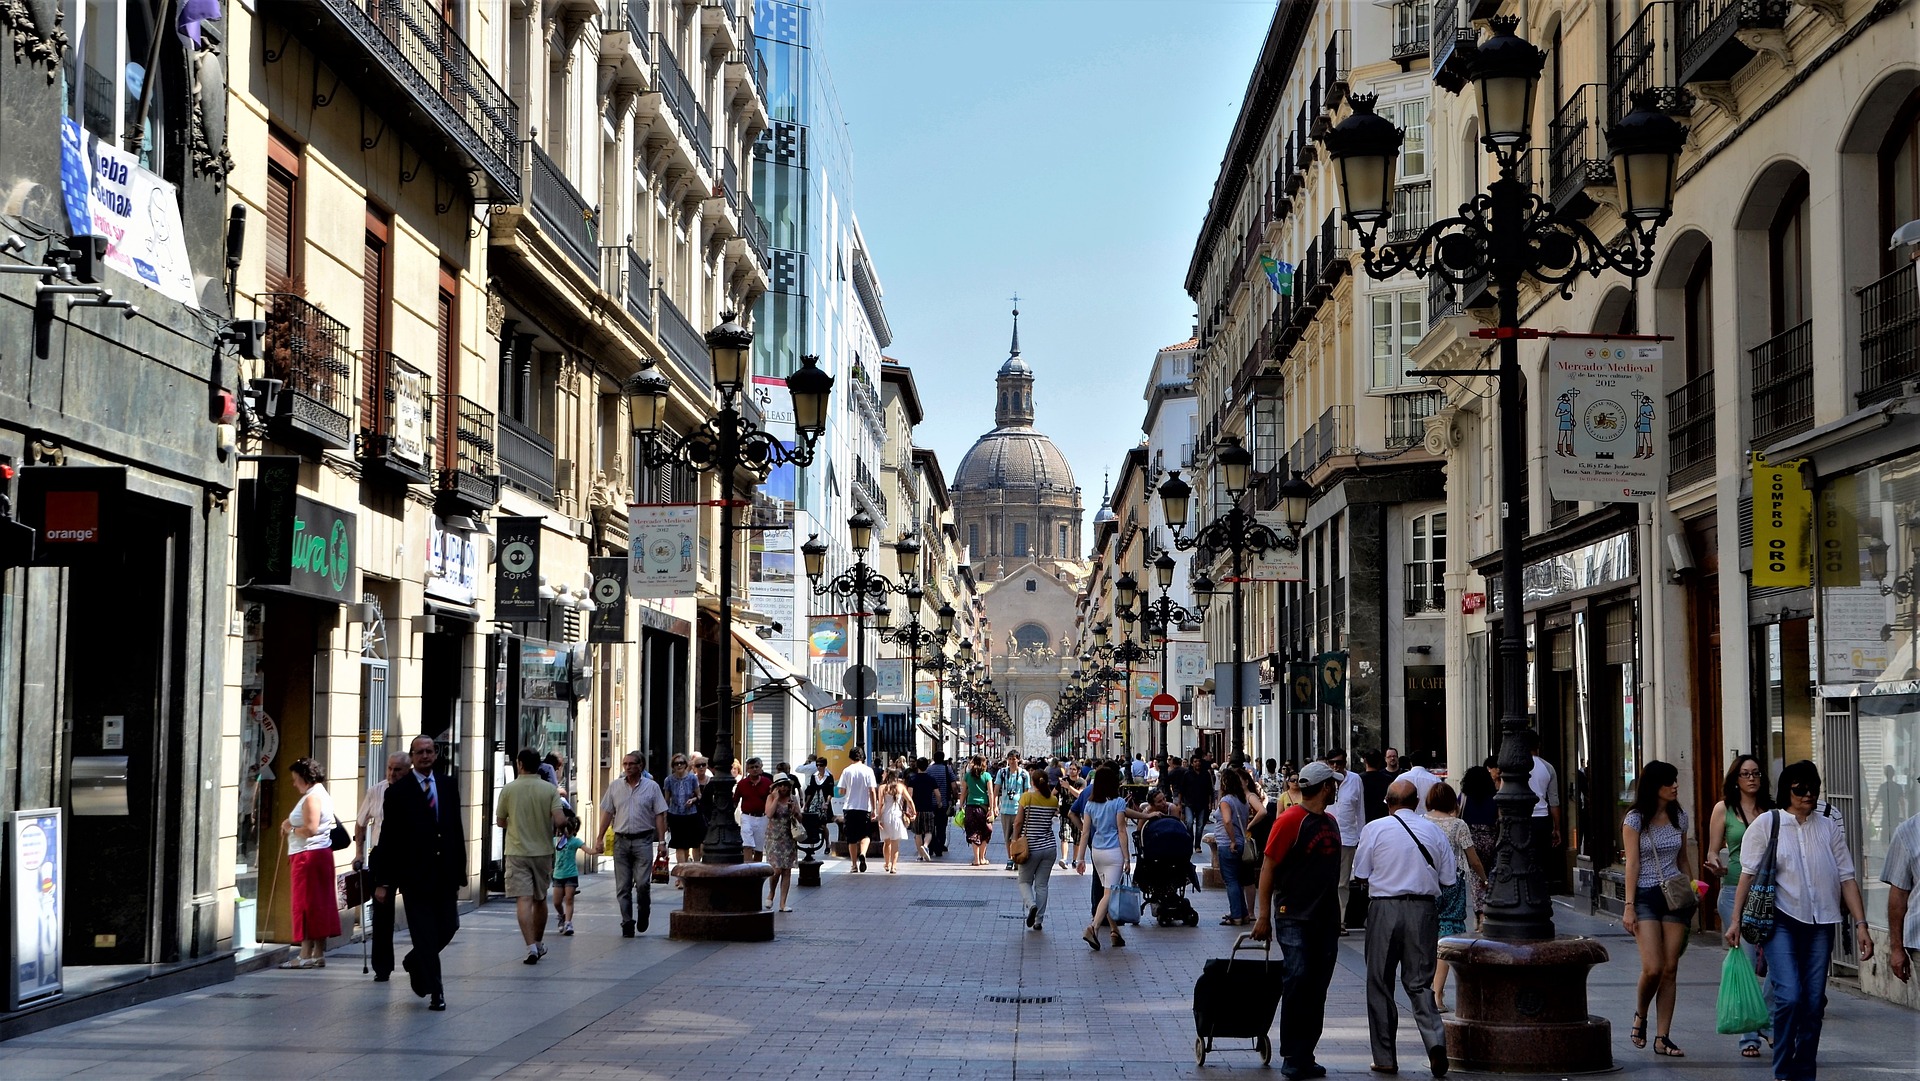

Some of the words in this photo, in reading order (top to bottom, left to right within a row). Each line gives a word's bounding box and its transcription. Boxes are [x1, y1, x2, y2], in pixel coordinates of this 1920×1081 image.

[1555, 361, 1603, 371] Mercado
[1604, 363, 1655, 373] Medieval
[1771, 473, 1784, 528] COMPRO
[46, 529, 94, 541] orange
[501, 534, 535, 546] CAFES
[1768, 539, 1786, 573] ORO
[502, 570, 533, 580] COPAS
[595, 571, 622, 582] CAFES
[595, 601, 619, 609] COPAS
[1408, 678, 1418, 689] IL
